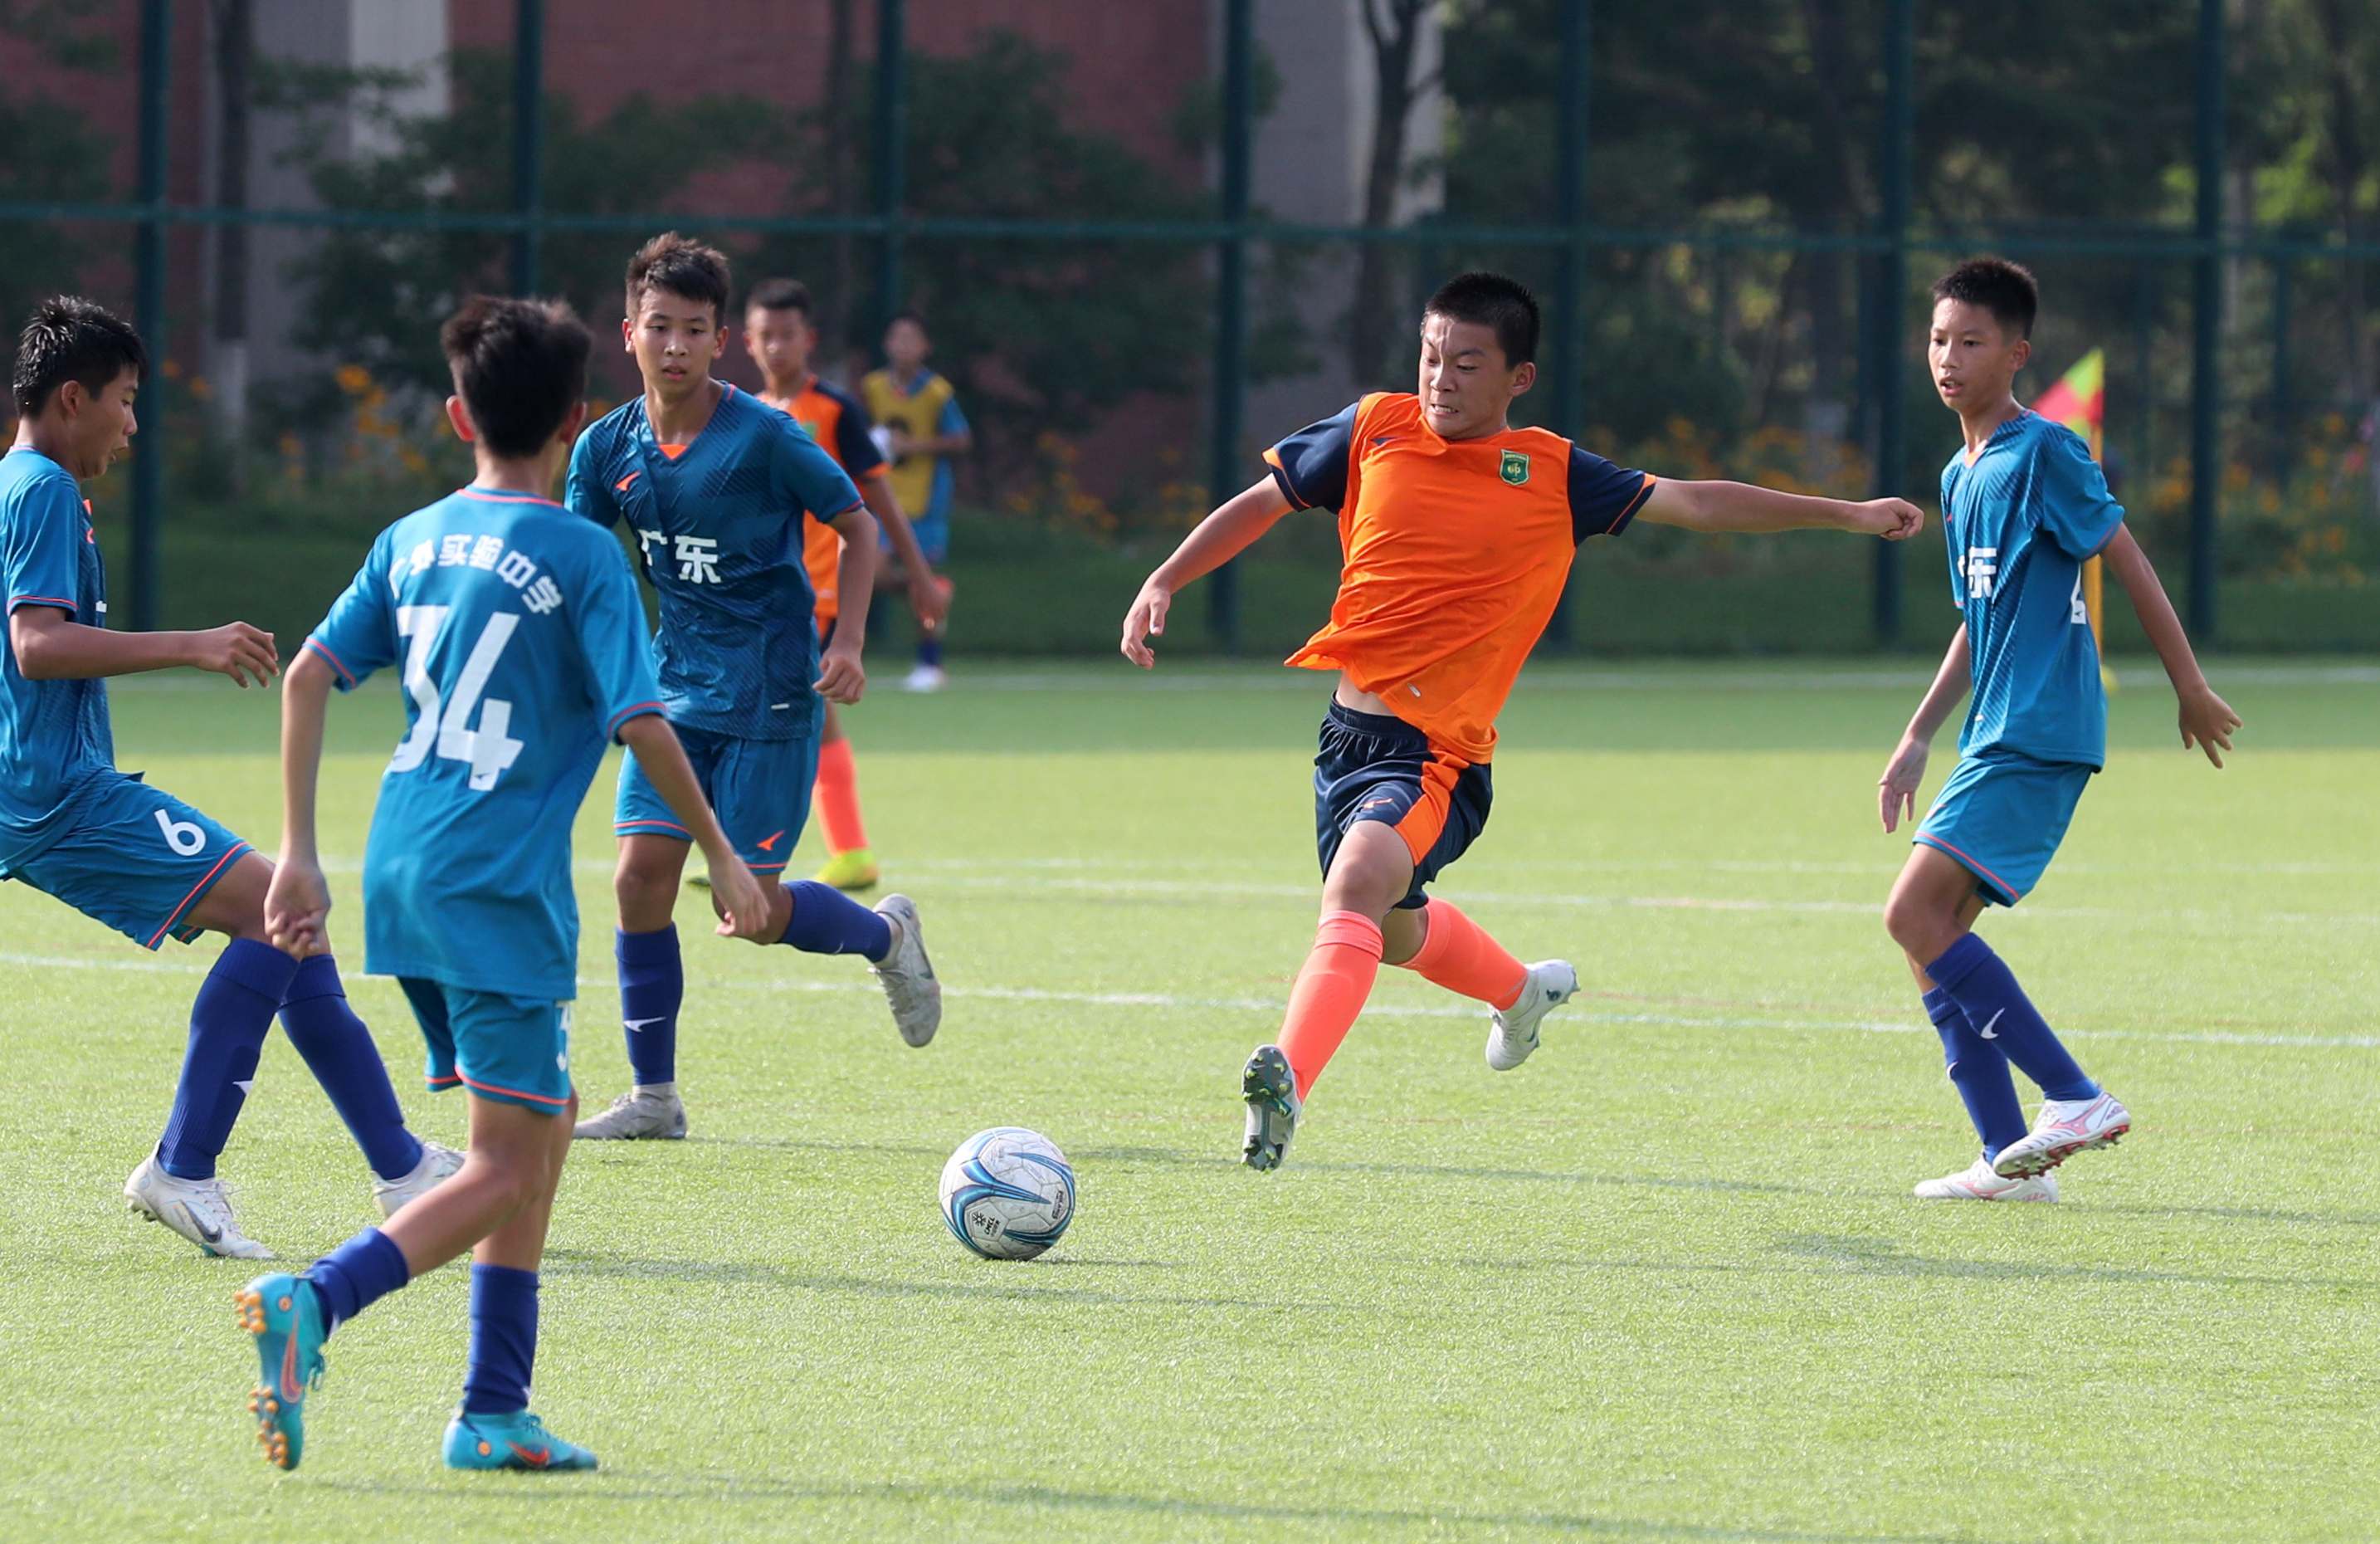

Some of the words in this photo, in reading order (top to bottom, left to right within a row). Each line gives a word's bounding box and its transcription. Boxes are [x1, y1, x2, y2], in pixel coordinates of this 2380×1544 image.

[637, 530, 721, 584] 广东
[388, 604, 524, 792] 34
[154, 809, 206, 856] 6
